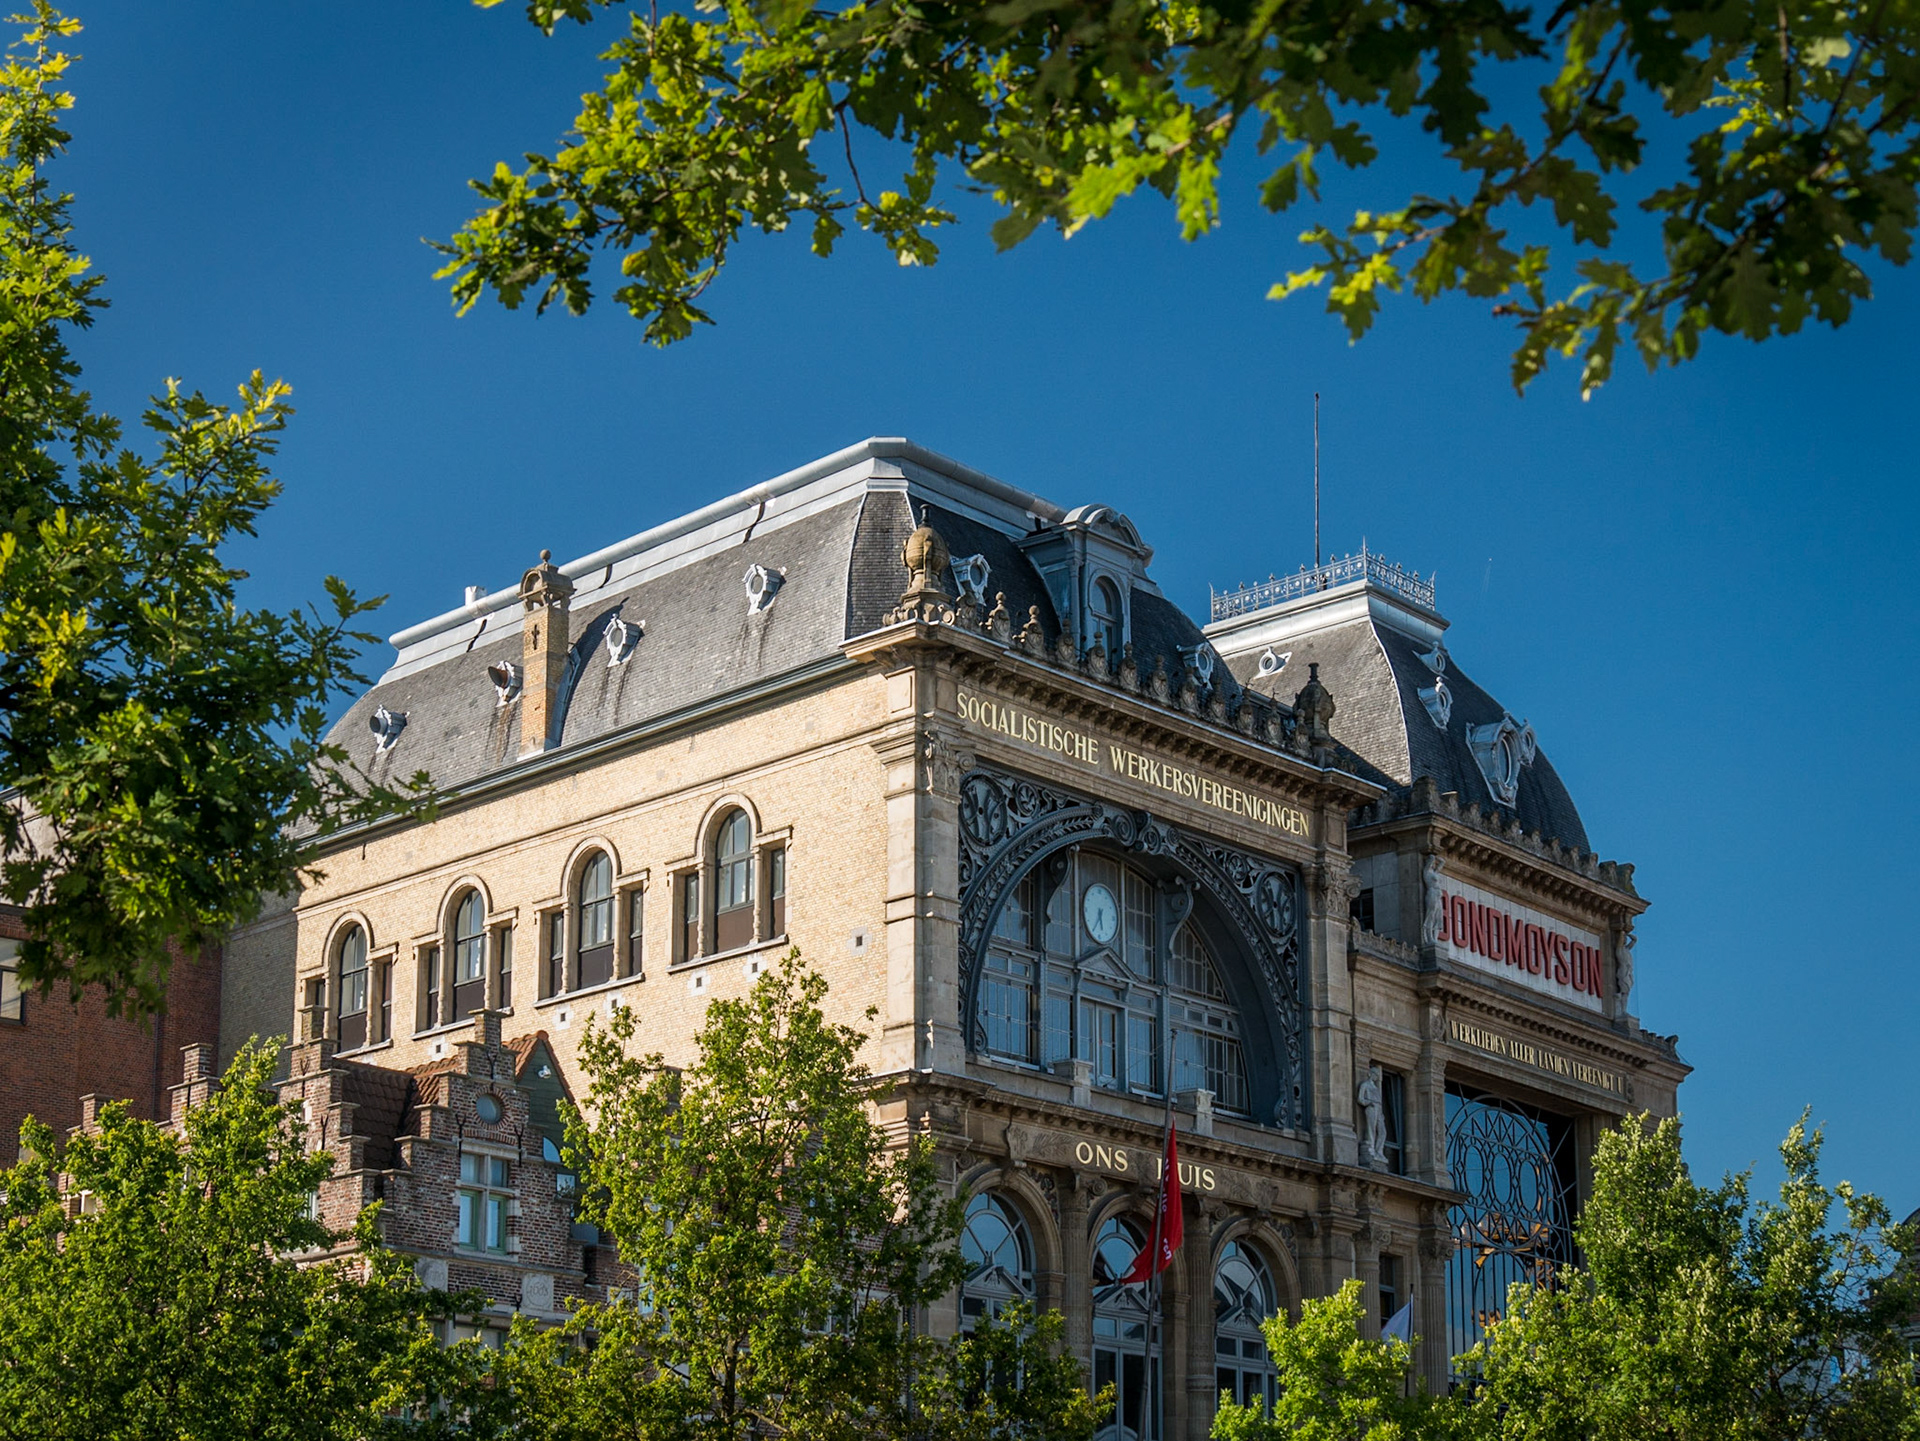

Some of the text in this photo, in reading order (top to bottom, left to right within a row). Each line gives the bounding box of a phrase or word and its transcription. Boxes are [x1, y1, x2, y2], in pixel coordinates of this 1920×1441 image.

[956, 691, 1310, 838] SOCIALISTISCHE WERKERSVEREENIGINGEN
[1451, 1019, 1507, 1055] WERKLIEDEN
[1509, 1040, 1536, 1066] ALLER
[1538, 1050, 1569, 1077] LANDEN
[1572, 1061, 1614, 1092] VEREENIGT
[1075, 1141, 1129, 1172] ONS
